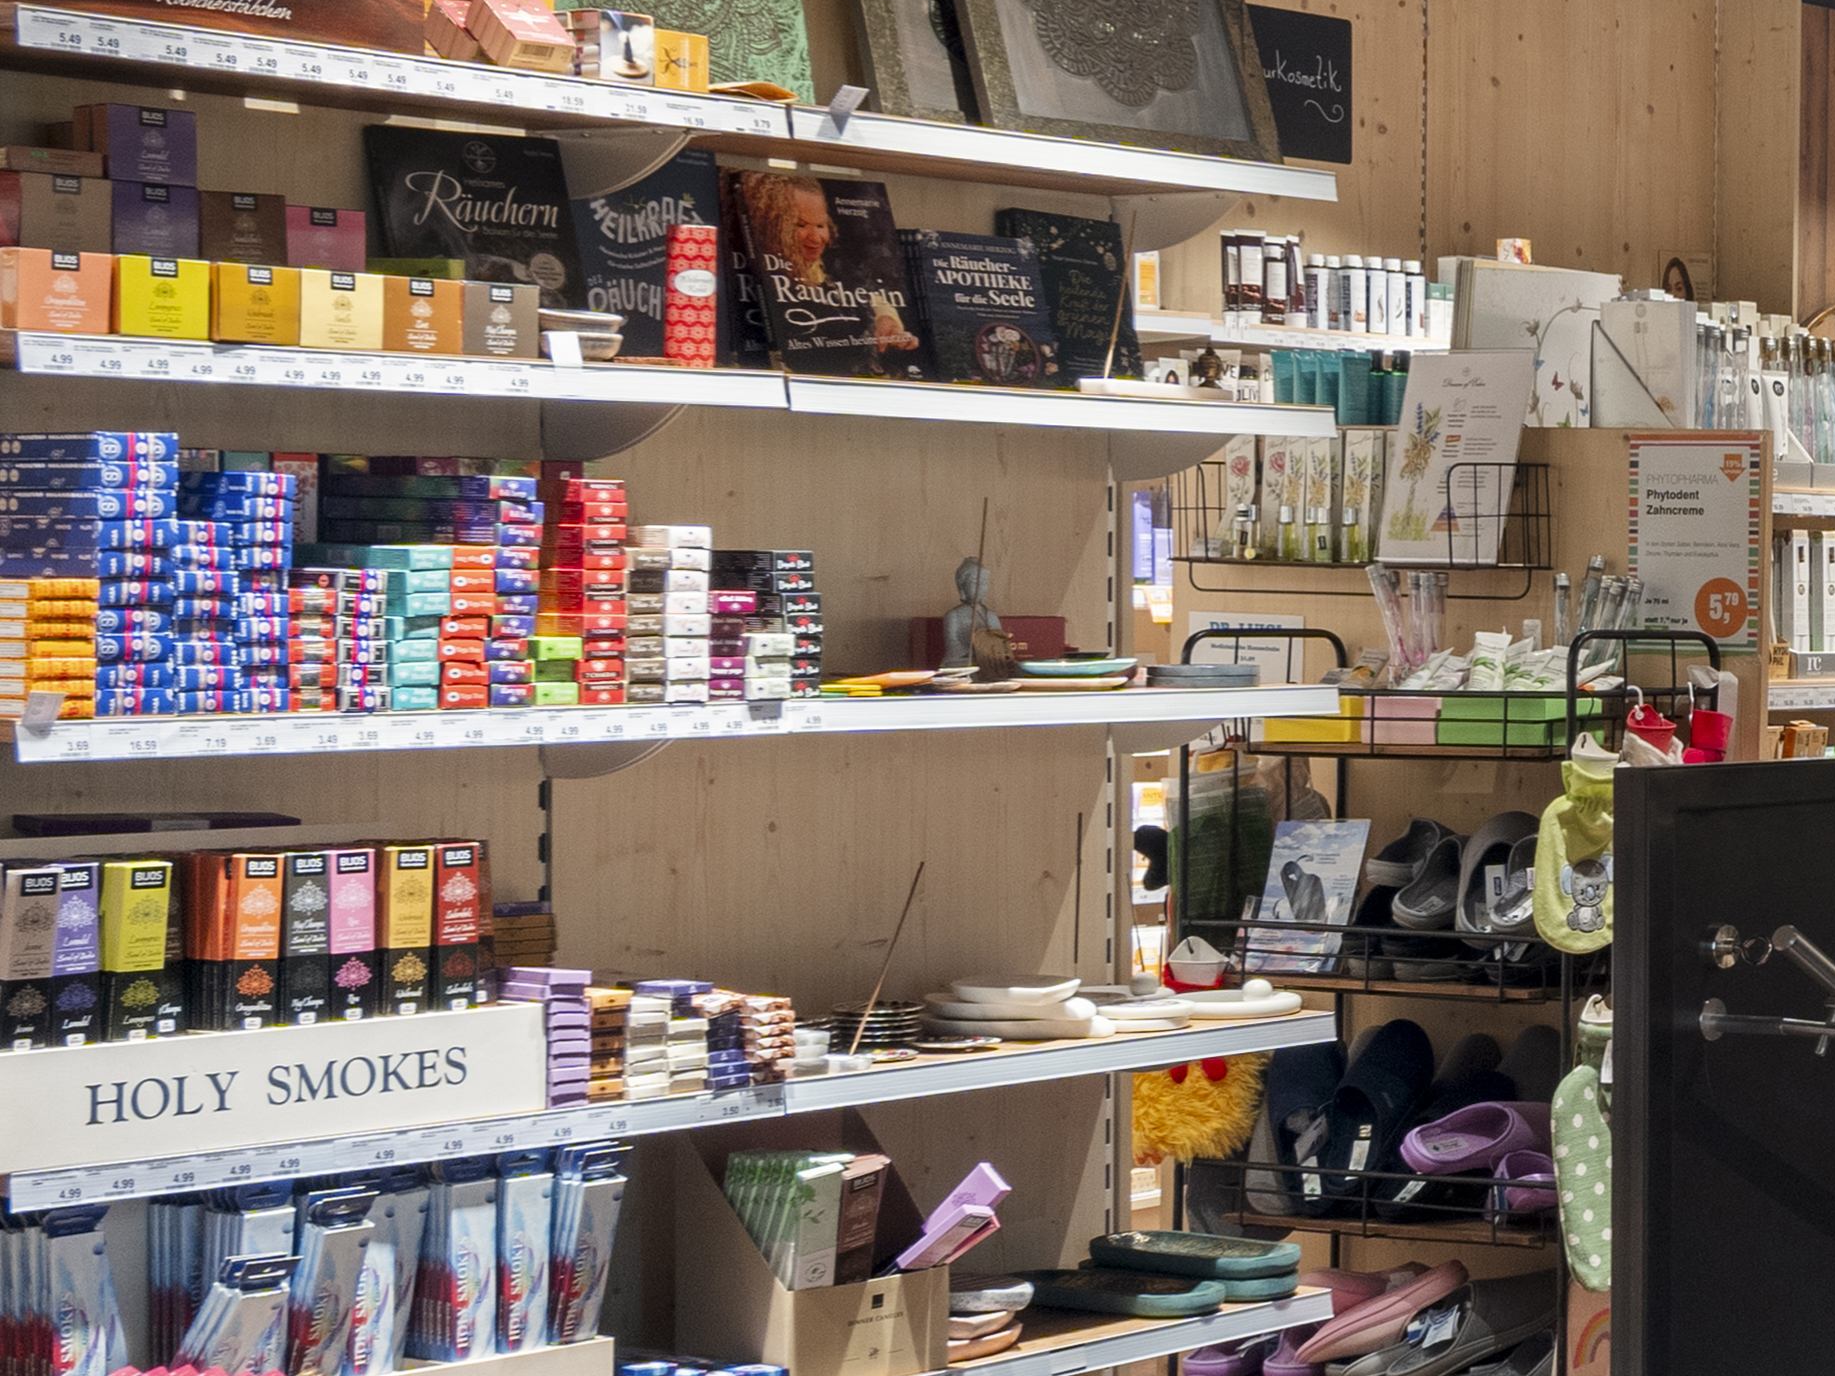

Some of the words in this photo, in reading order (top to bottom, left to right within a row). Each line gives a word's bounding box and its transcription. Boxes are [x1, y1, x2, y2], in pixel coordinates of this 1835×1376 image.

[59, 33, 82, 45] 5.49
[98, 36, 120, 49] 5.49
[166, 45, 187, 57] 5.49
[216, 53, 237, 65] 5.49
[1262, 49, 1342, 93] urKosmetik
[405, 170, 558, 233] Räuchern
[835, 196, 880, 208] Annemarie
[837, 206, 868, 219] Herzog
[764, 253, 793, 271] Die
[933, 258, 949, 269] Die
[950, 255, 1017, 273] Räucher-
[934, 269, 1032, 291] APOTHEKE
[774, 274, 906, 309] Räucherin
[955, 292, 970, 305] für
[972, 293, 987, 305] die
[989, 290, 1035, 308] Seele
[1646, 489, 1700, 501] Phytodent
[1646, 504, 1705, 516] Zahncreme
[1709, 592, 1739, 624] 5,79
[85, 1070, 239, 1125] HOLY
[267, 1046, 467, 1106] SMOKES
[554, 1127, 571, 1137] 4.99
[609, 1121, 626, 1131] 4.99
[495, 1134, 513, 1144] 4.99
[444, 1140, 462, 1151] 4.99
[375, 1149, 394, 1160] 4.99
[230, 1164, 251, 1175] 4.99
[280, 1159, 300, 1170] 4.99
